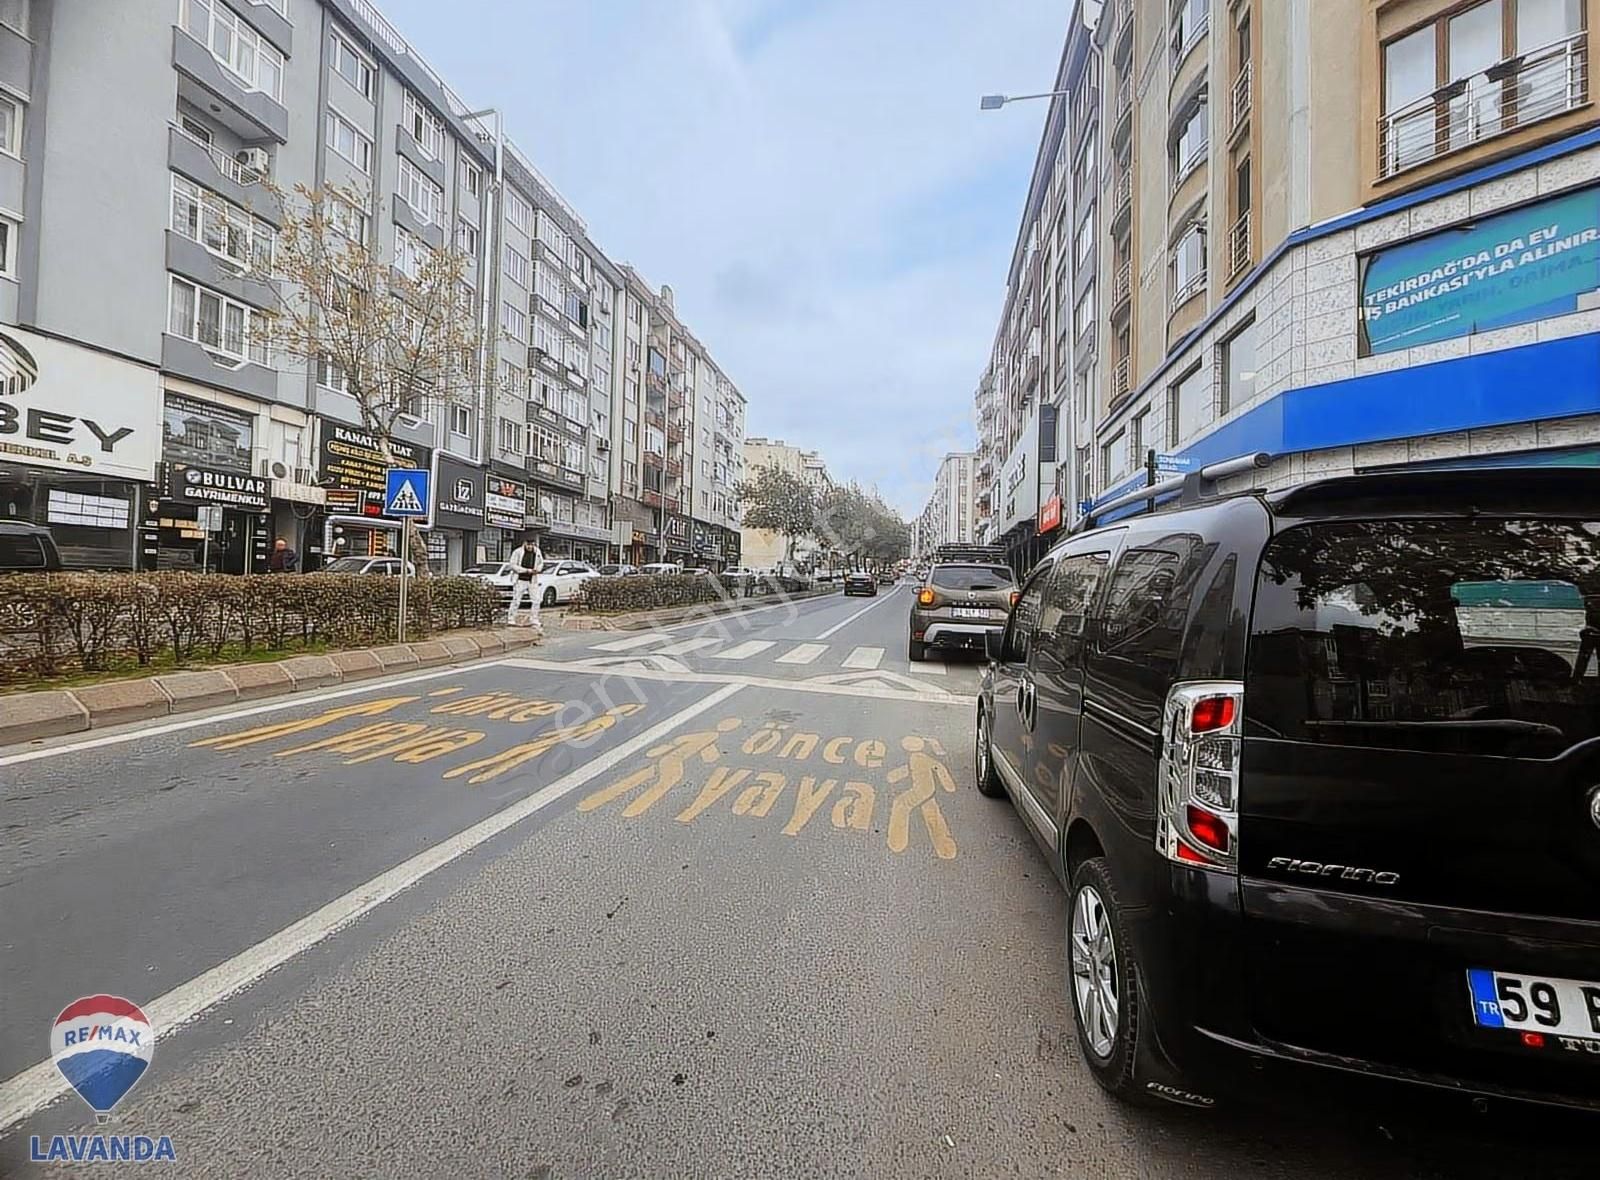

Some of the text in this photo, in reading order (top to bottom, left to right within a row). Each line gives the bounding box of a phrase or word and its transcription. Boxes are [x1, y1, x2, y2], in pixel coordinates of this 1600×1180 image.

[1365, 225, 1558, 306] TEKİRDAĞ'DA DA EV
[1385, 258, 1514, 314] BANKASI'YLA
[203, 472, 266, 494] BULVAR
[742, 721, 886, 768] önce
[675, 766, 876, 836] yaya
[1480, 1000, 1500, 1016] TR
[1497, 977, 1561, 1028] 59
